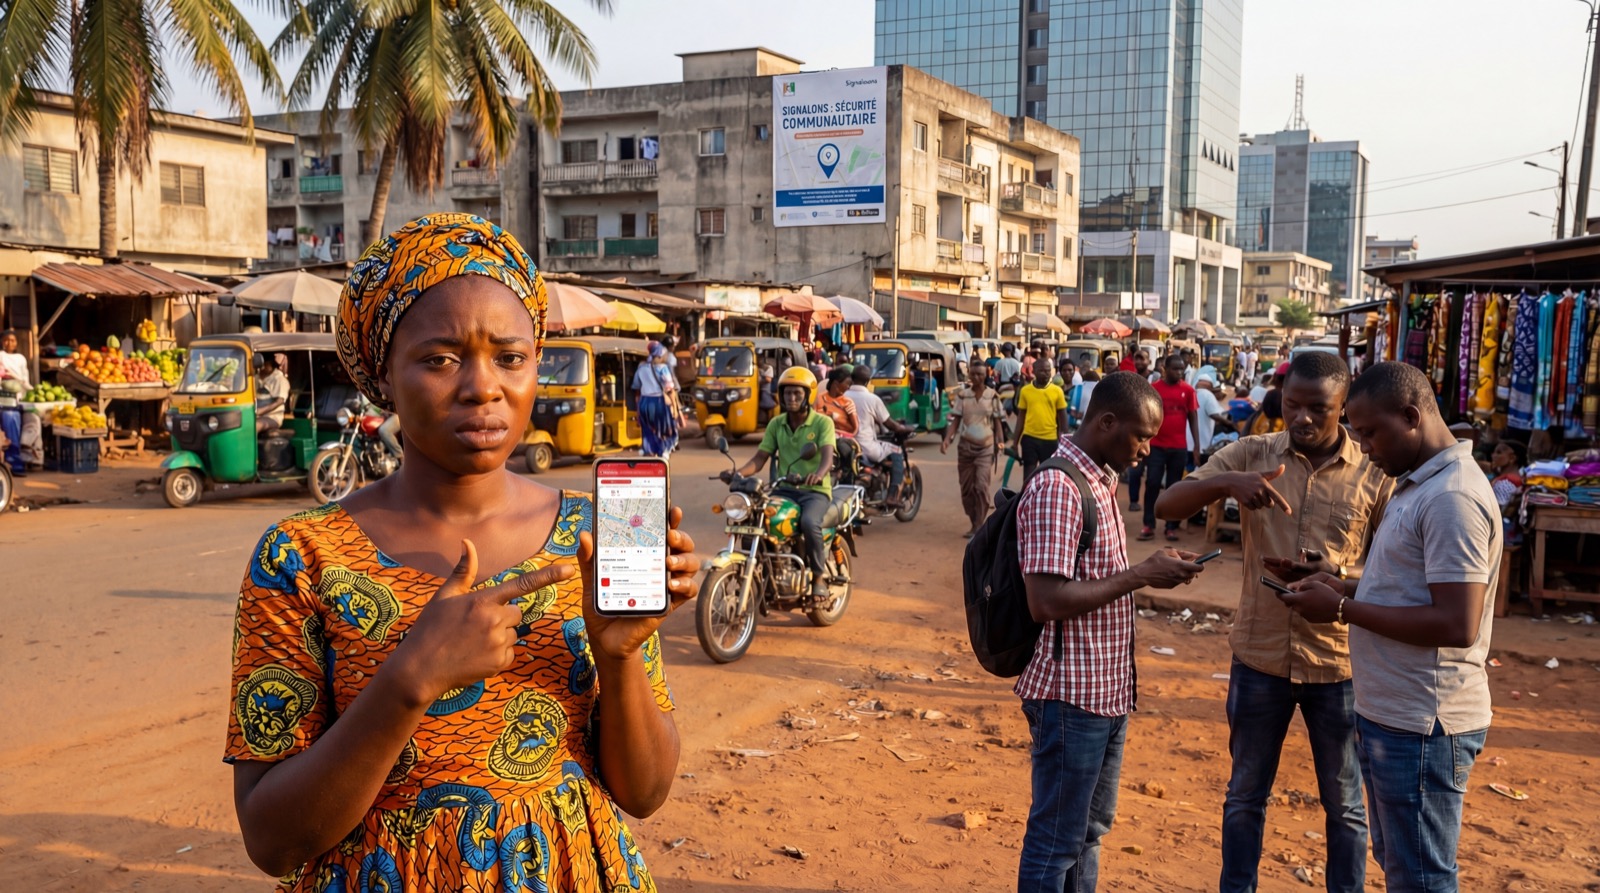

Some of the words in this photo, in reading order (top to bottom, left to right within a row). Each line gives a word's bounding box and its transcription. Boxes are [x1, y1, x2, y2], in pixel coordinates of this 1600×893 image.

[782, 104, 829, 116] SIGNALONS
[835, 98, 877, 112] SÉCURITÉ
[783, 112, 876, 129] COMMUNAUTAIRE
